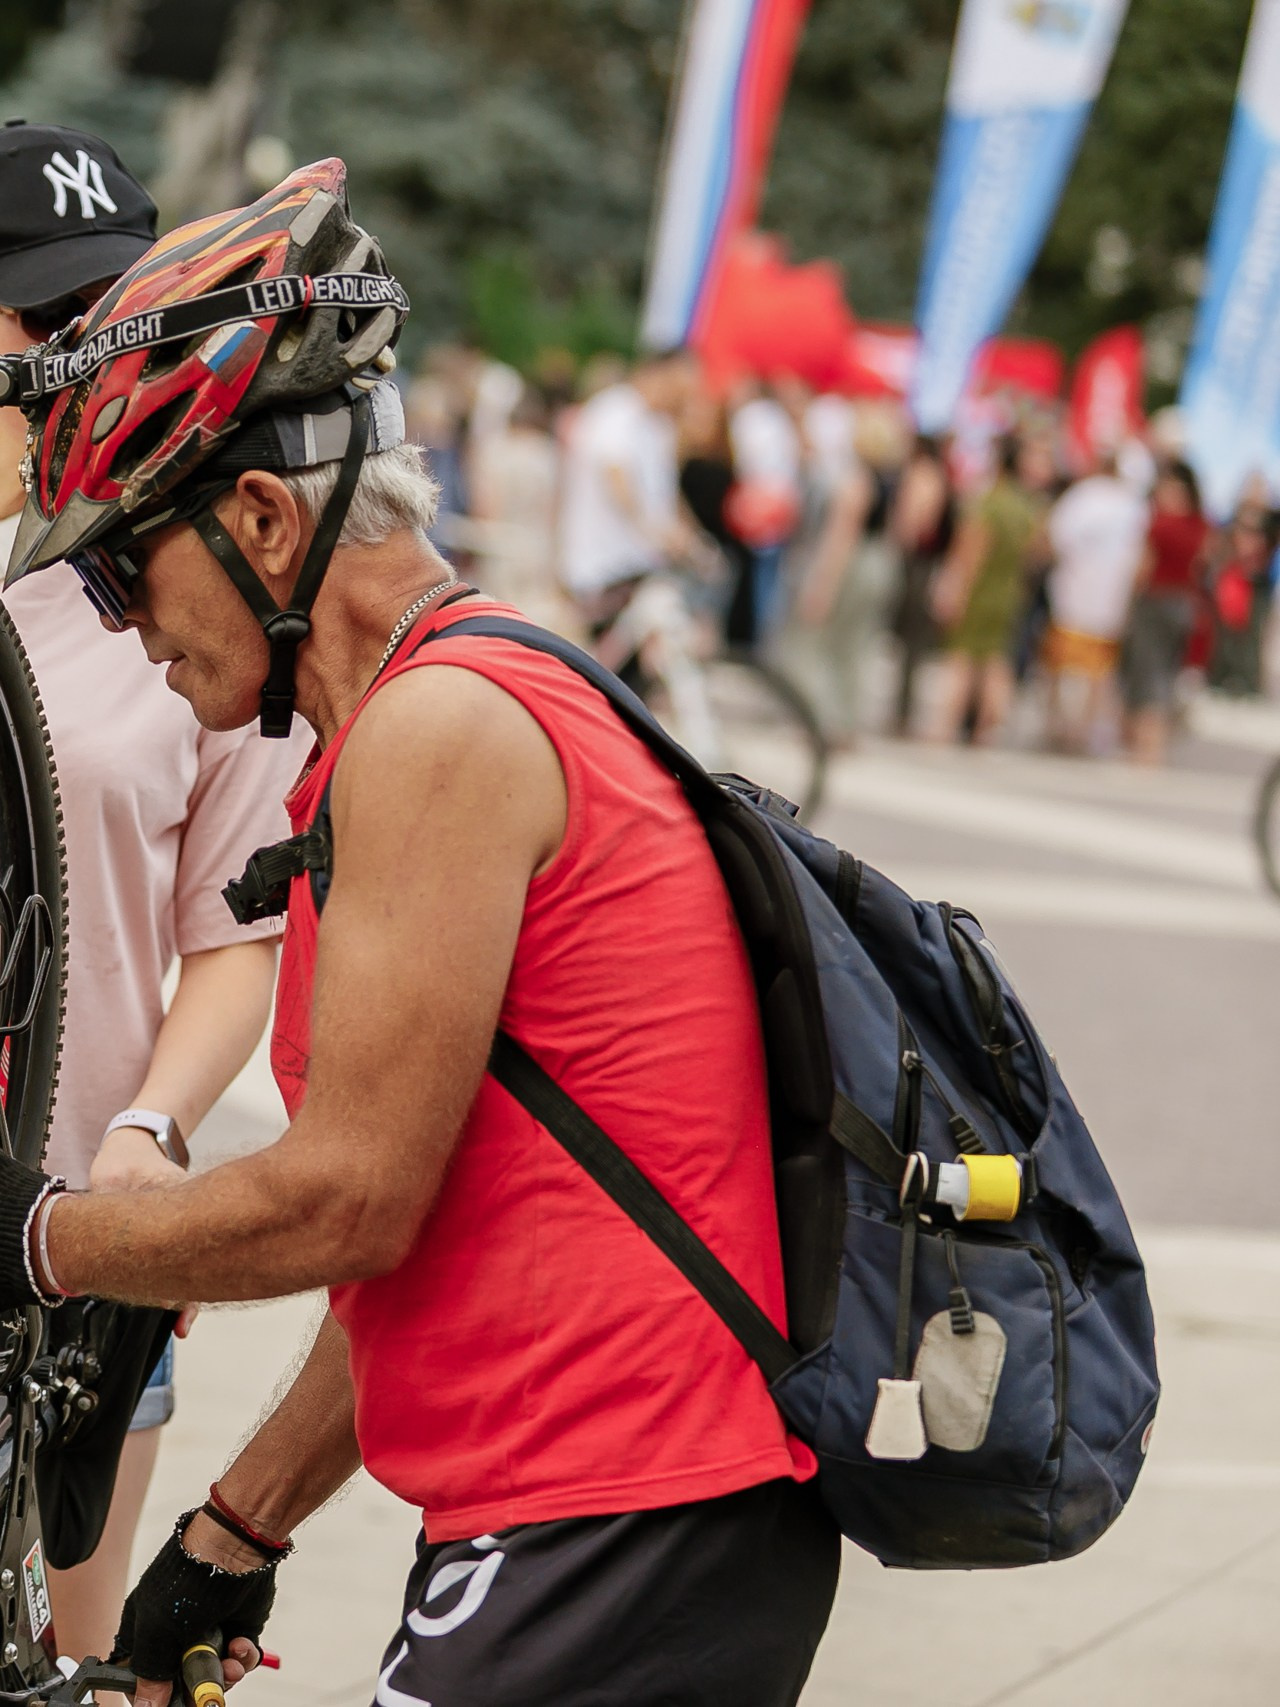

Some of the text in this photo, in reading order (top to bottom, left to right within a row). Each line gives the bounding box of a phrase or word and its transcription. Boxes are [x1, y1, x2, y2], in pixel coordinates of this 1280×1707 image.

[43, 150, 118, 219] NY
[69, 312, 165, 378] HEADLIGHT
[246, 278, 295, 313] LED
